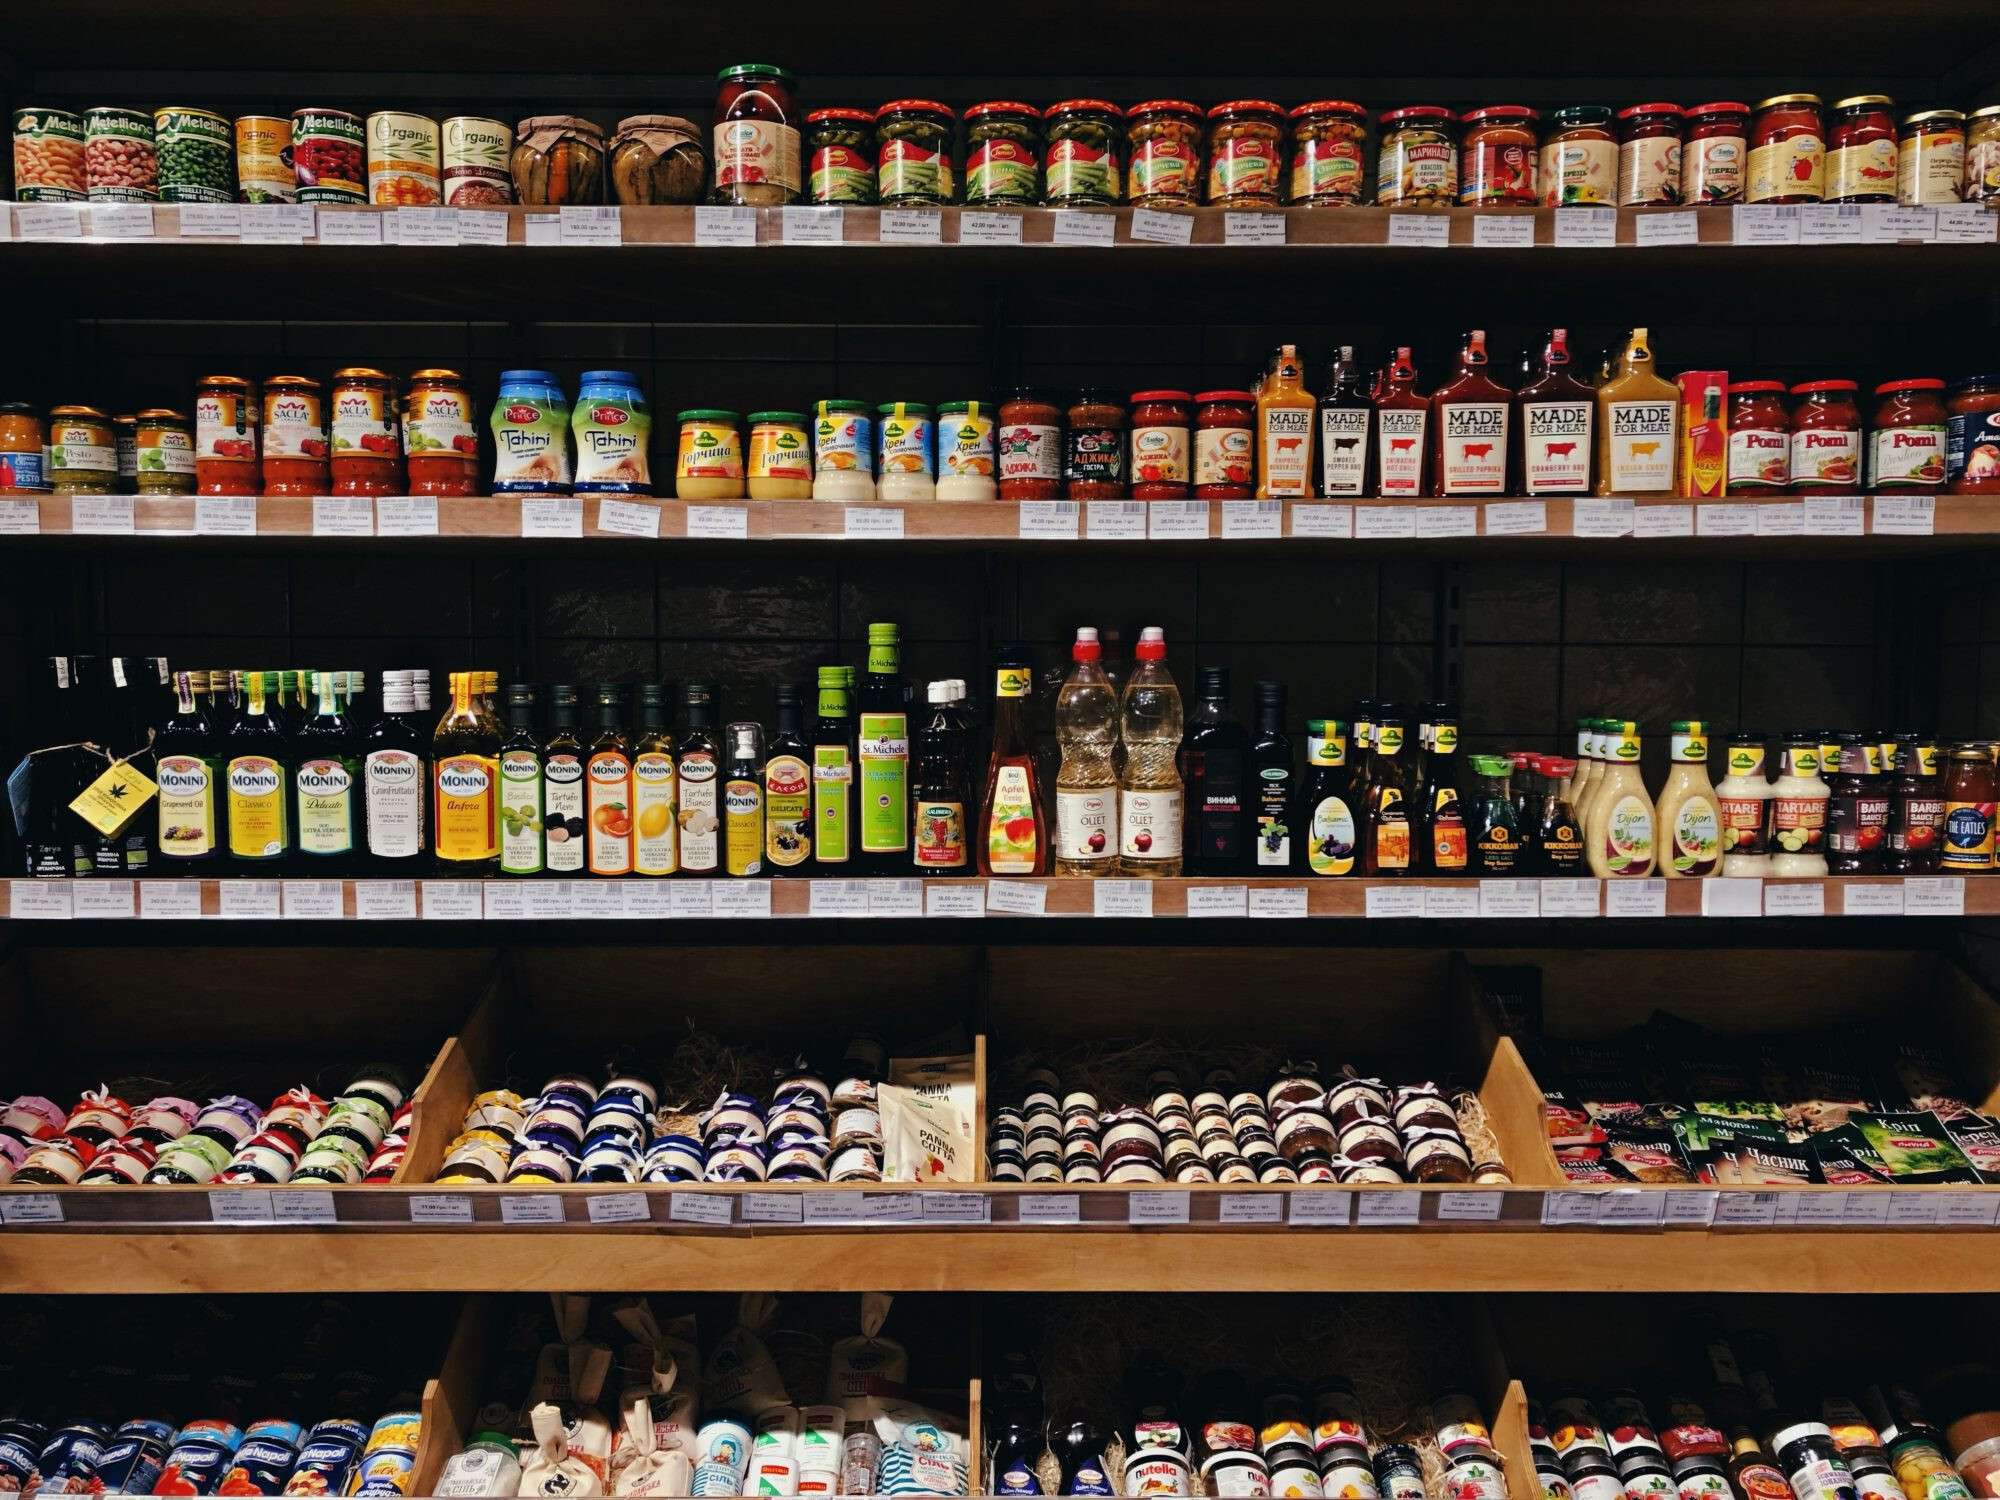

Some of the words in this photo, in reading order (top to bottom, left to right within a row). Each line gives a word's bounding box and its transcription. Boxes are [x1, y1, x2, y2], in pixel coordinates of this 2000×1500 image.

[503, 407, 540, 422] Prince
[591, 408, 627, 424] Prince
[1270, 413, 1308, 425] MADE
[1327, 413, 1365, 425] MADE
[1383, 415, 1421, 425] MADE
[1449, 411, 1503, 425] MADE
[1531, 409, 1586, 425] MADE
[1615, 409, 1670, 424] MADE
[1269, 424, 1285, 432] FOR
[1286, 424, 1308, 432] MEAT
[1326, 424, 1342, 432] FOR
[1344, 423, 1365, 431] MEAT
[1382, 424, 1398, 432] FOR
[1400, 424, 1421, 432] MEAT
[1449, 425, 1470, 435] FOR
[1472, 425, 1503, 434] MEAT
[1531, 424, 1553, 434] FOR
[1555, 423, 1587, 433] MEAT
[1614, 423, 1637, 433] FOR
[1638, 423, 1670, 432] MEAT
[500, 430, 550, 450] Tahini
[584, 431, 637, 451] Tahini
[1975, 431, 2000, 442] Ama
[884, 438, 906, 450] Хрен
[955, 441, 981, 453] Хрен
[1074, 453, 1115, 465] АДЖИКА
[1005, 462, 1038, 473] АДЖИКА
[873, 743, 905, 754] Michele
[373, 766, 412, 776] MONINI
[504, 763, 537, 773] MONINI
[548, 765, 580, 774] MONINI
[592, 765, 626, 775] MONINI
[638, 766, 671, 775] MONINI
[682, 764, 714, 774] MONINI
[161, 775, 204, 786] MONINI
[232, 774, 277, 786] MONINI
[300, 775, 347, 786] MONINI
[441, 775, 486, 788] MONINI
[1001, 785, 1024, 795] Apfel
[237, 800, 272, 808] Classico
[1777, 802, 1825, 814] TARTARE
[1861, 803, 1888, 813] BARBE
[1616, 812, 1645, 826] Dijon
[1683, 812, 1712, 826] Dijon
[1861, 813, 1882, 821] SAUCE
[1910, 813, 1934, 821] SAUCE
[1877, 1118, 1922, 1132] Кріп
[919, 1129, 956, 1157] PANNA
[921, 1139, 954, 1164] COTTA
[1746, 1146, 1810, 1171] Часник
[1135, 1464, 1177, 1478] nutella
